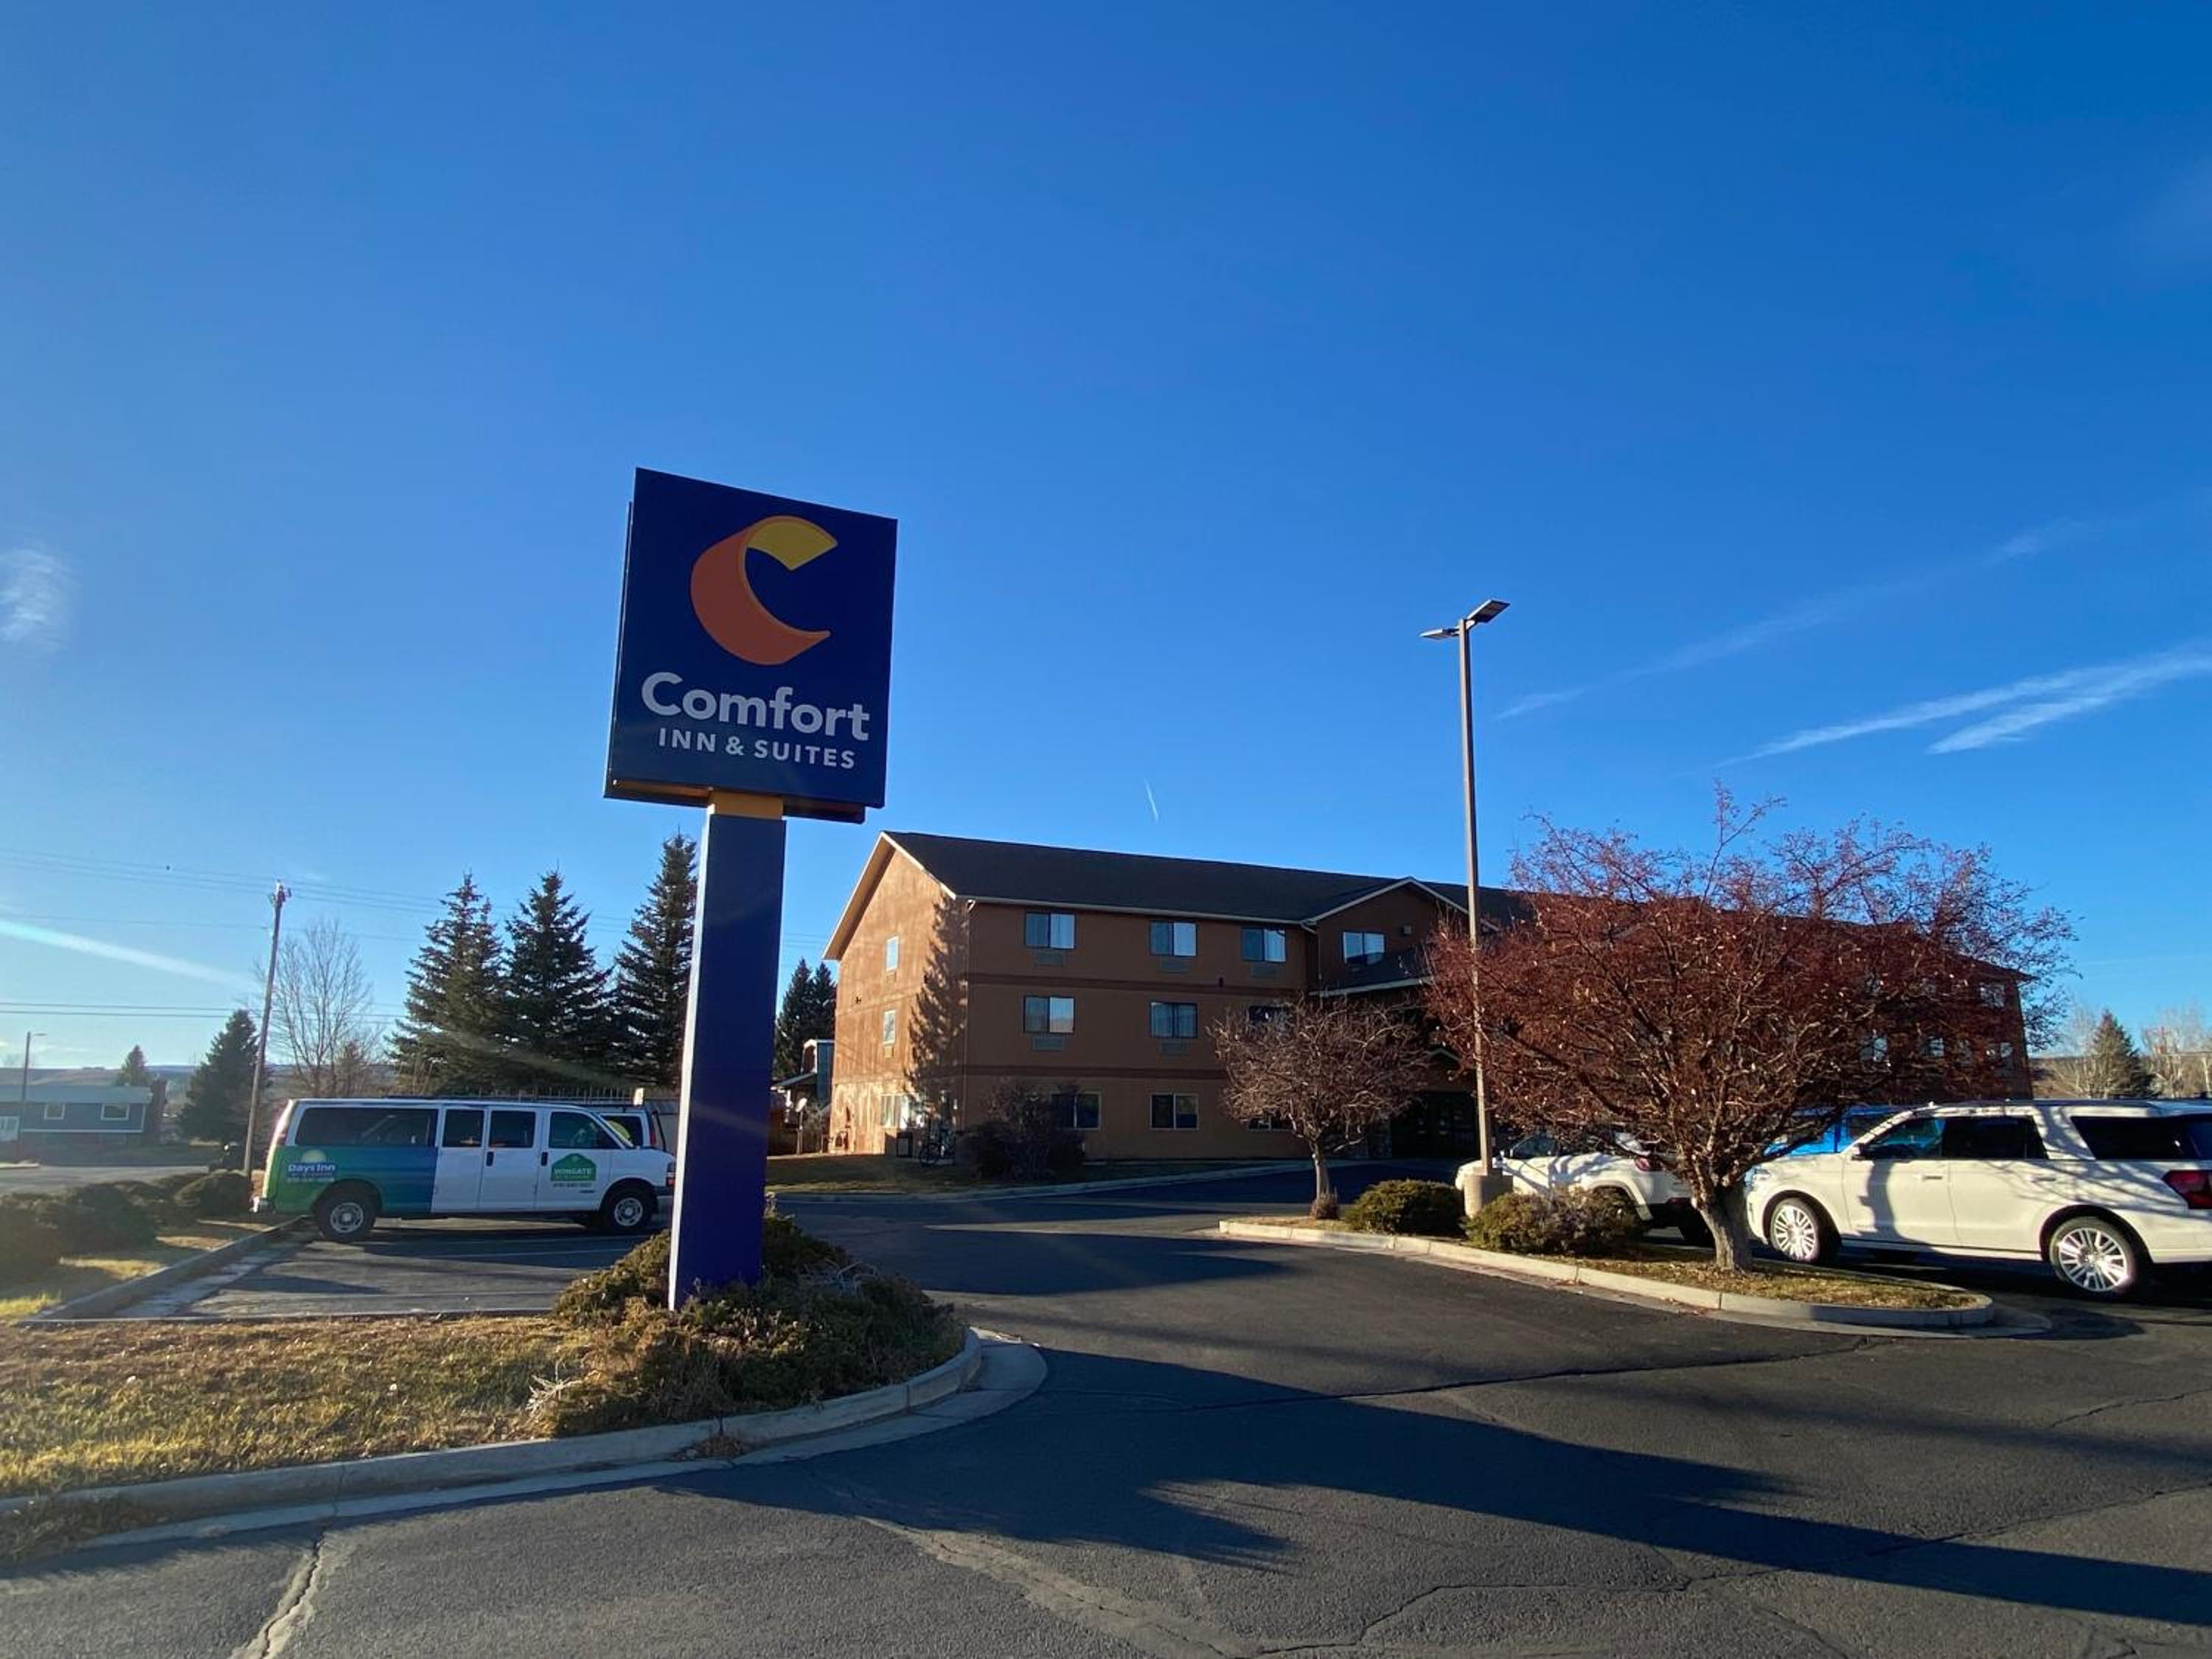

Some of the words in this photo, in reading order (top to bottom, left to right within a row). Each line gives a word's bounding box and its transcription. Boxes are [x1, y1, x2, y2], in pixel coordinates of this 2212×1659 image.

[641, 672, 870, 741] Comfort
[658, 728, 716, 752] INN
[725, 736, 745, 756] &
[754, 740, 855, 769] SUITES
